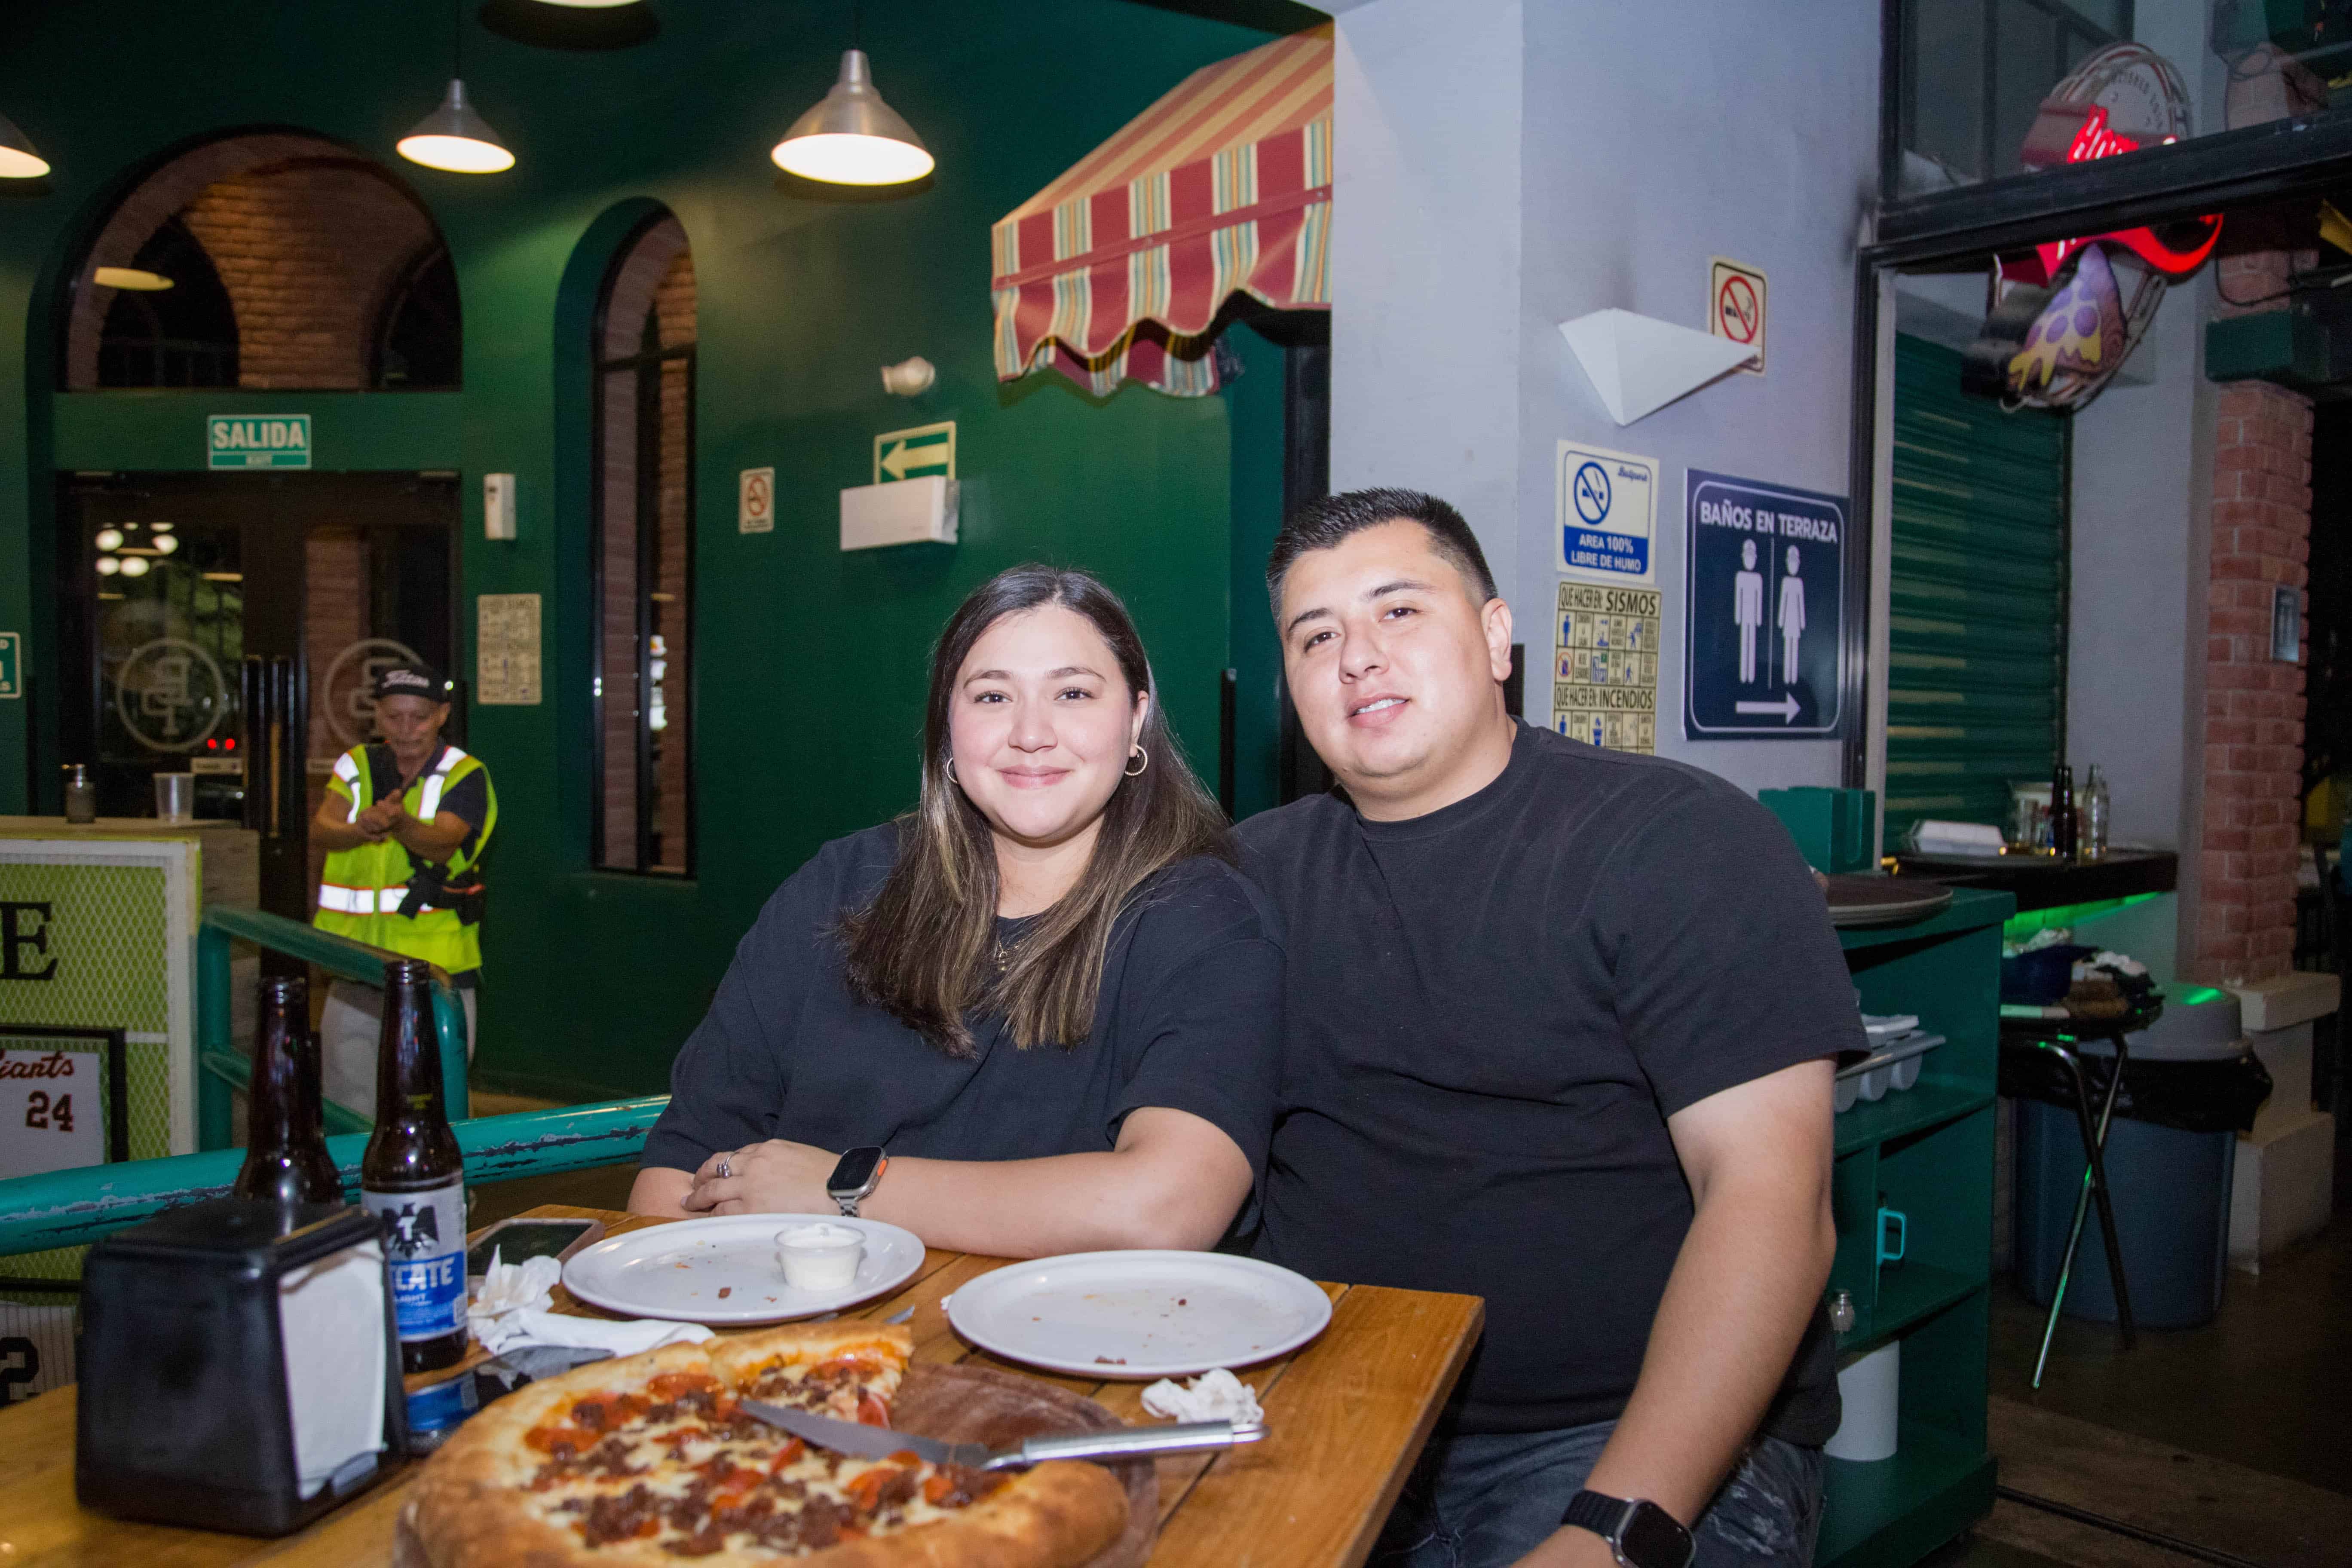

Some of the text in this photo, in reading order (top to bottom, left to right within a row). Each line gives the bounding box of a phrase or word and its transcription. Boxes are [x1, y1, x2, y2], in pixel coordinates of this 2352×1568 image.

[214, 421, 304, 448] SALIDA
[1700, 499, 1838, 543] BAÑOS EN TERRAZA
[1579, 534, 1634, 554] AREA 100%
[1571, 550, 1641, 573] LIBRE DE HUMO
[1561, 587, 1574, 607] QUE
[1575, 589, 1593, 608] HACER
[1606, 591, 1656, 615] SISMOS
[1557, 687, 1568, 707] QUE
[1570, 689, 1588, 706] HACER
[1599, 689, 1653, 709] INCENDIOS
[0, 1048, 74, 1079] iants
[26, 1090, 74, 1133] 24
